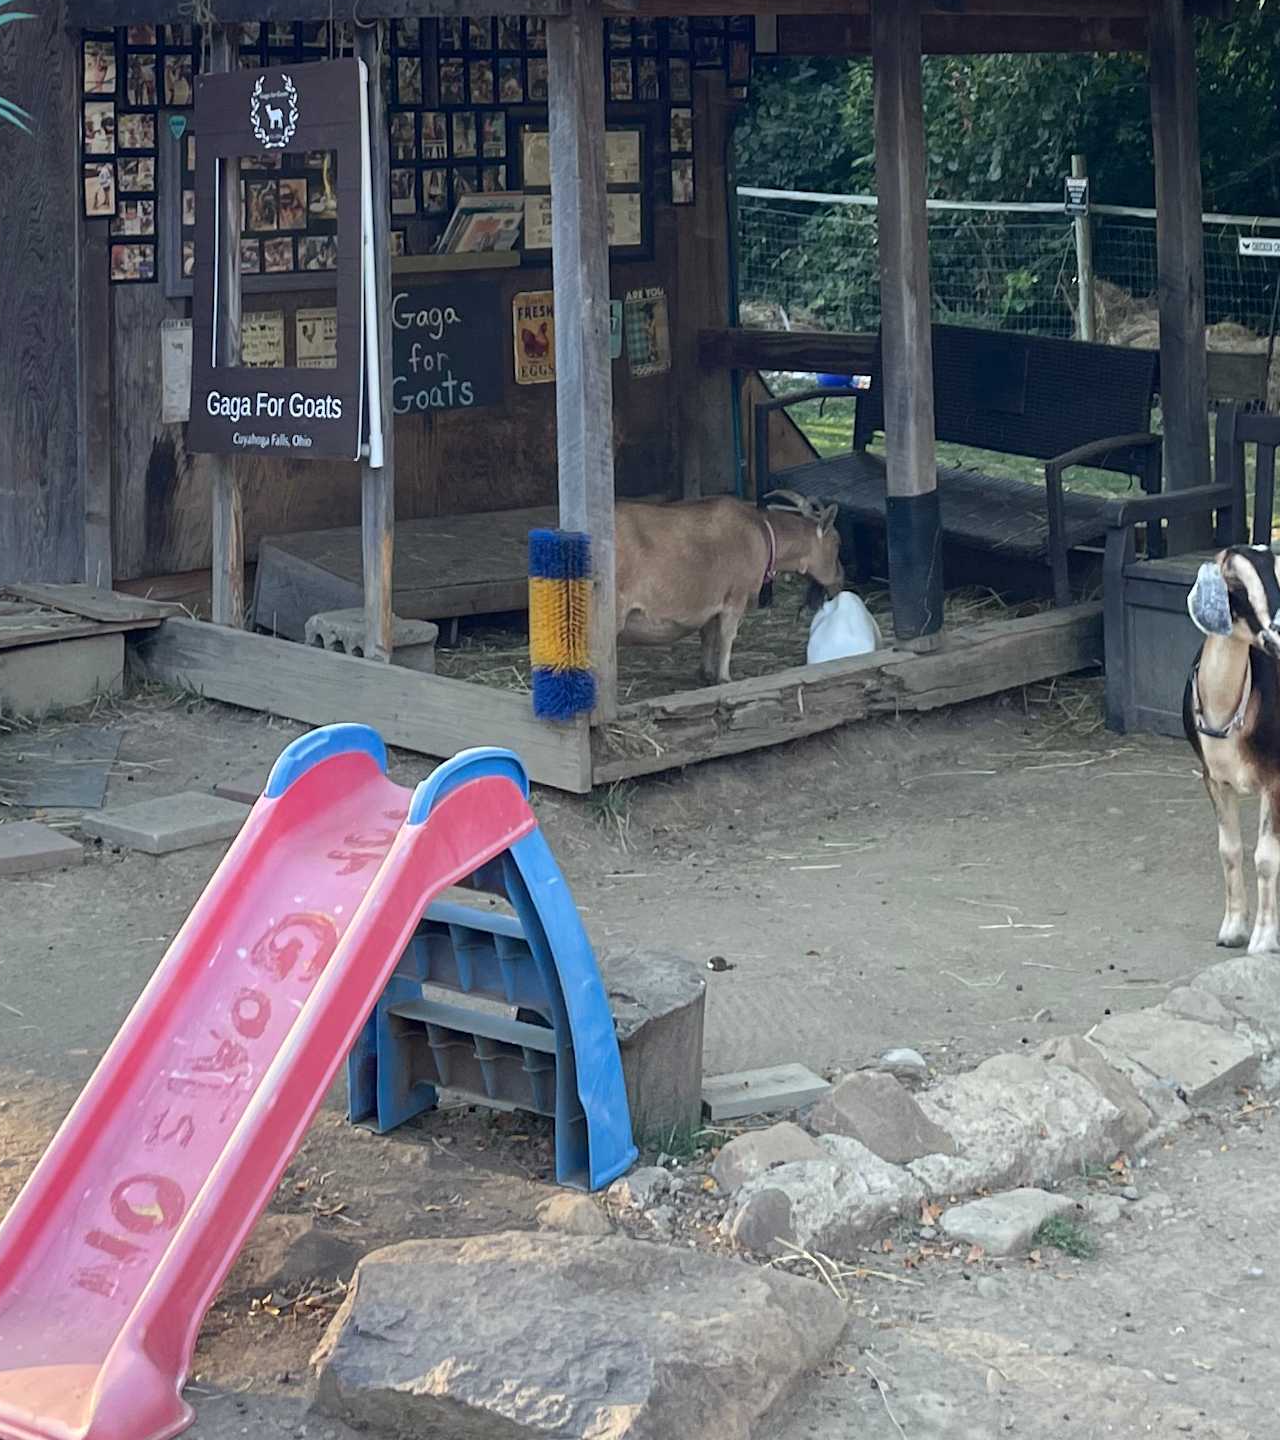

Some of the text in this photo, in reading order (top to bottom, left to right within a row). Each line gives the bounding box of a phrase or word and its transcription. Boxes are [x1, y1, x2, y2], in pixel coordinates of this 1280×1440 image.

[391, 292, 461, 340] Gaga
[517, 305, 554, 321] FRESH
[408, 342, 449, 373] for
[207, 391, 342, 422] Gaga For Goats
[391, 369, 474, 414] Goats
[232, 432, 270, 448] Cuyahoga
[292, 434, 312, 447] Ohio
